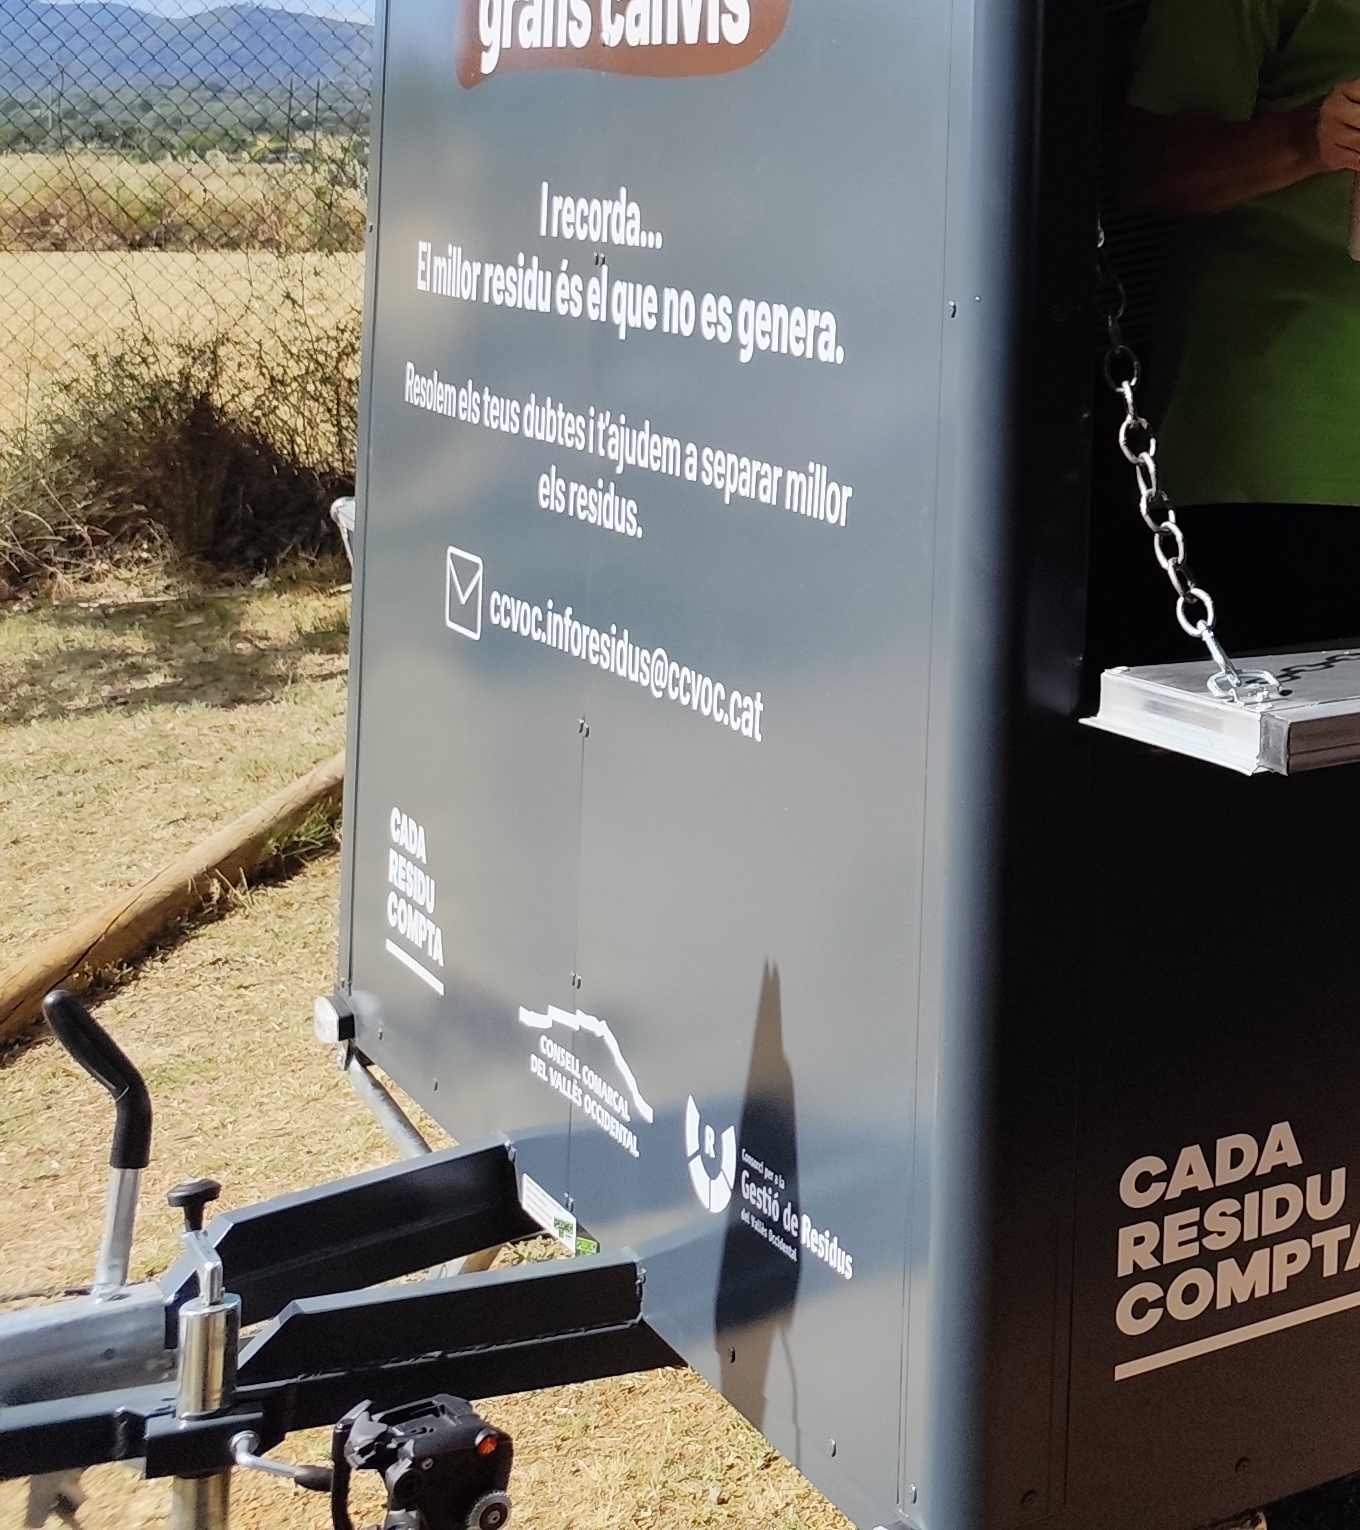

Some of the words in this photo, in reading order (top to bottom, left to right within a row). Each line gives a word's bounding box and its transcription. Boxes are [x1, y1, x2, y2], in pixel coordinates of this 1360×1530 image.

[540, 181, 548, 236] I
[552, 186, 662, 249] recorda...
[417, 241, 432, 292] El
[433, 243, 481, 300] millor
[483, 252, 551, 313] residu
[555, 259, 583, 318] és
[587, 264, 608, 322] el
[612, 281, 658, 340] que
[662, 286, 696, 337] no
[701, 292, 733, 343] es
[738, 297, 845, 364] genera.
[404, 361, 457, 417] Resolem
[458, 379, 481, 425] els
[483, 386, 521, 434] teus
[523, 394, 586, 451] dubtes
[588, 406, 594, 454] i
[597, 410, 682, 477] t'ajudem
[685, 442, 698, 482] a
[701, 445, 783, 504] separar
[785, 461, 853, 527] millor
[538, 465, 565, 513] els
[569, 478, 643, 539] residus.
[490, 590, 764, 742] ccvoc.inforesidus@ccvoc.cat
[390, 806, 428, 865] CADA
[388, 847, 436, 914] RESIDU
[386, 890, 445, 967] COMPTA
[530, 1053, 548, 1082] DEL
[549, 1066, 583, 1107] VALLÈS
[583, 1094, 640, 1158] OCCIDENTAL
[540, 1034, 581, 1079] CONSELL
[582, 1064, 631, 1122] COMARCAL
[704, 1124, 715, 1158] R
[1119, 1121, 1303, 1209] CADA
[741, 1170, 780, 1222] Gestió
[782, 1201, 799, 1238] de
[800, 1213, 853, 1280] Residus
[1117, 1166, 1347, 1278] RESIDU
